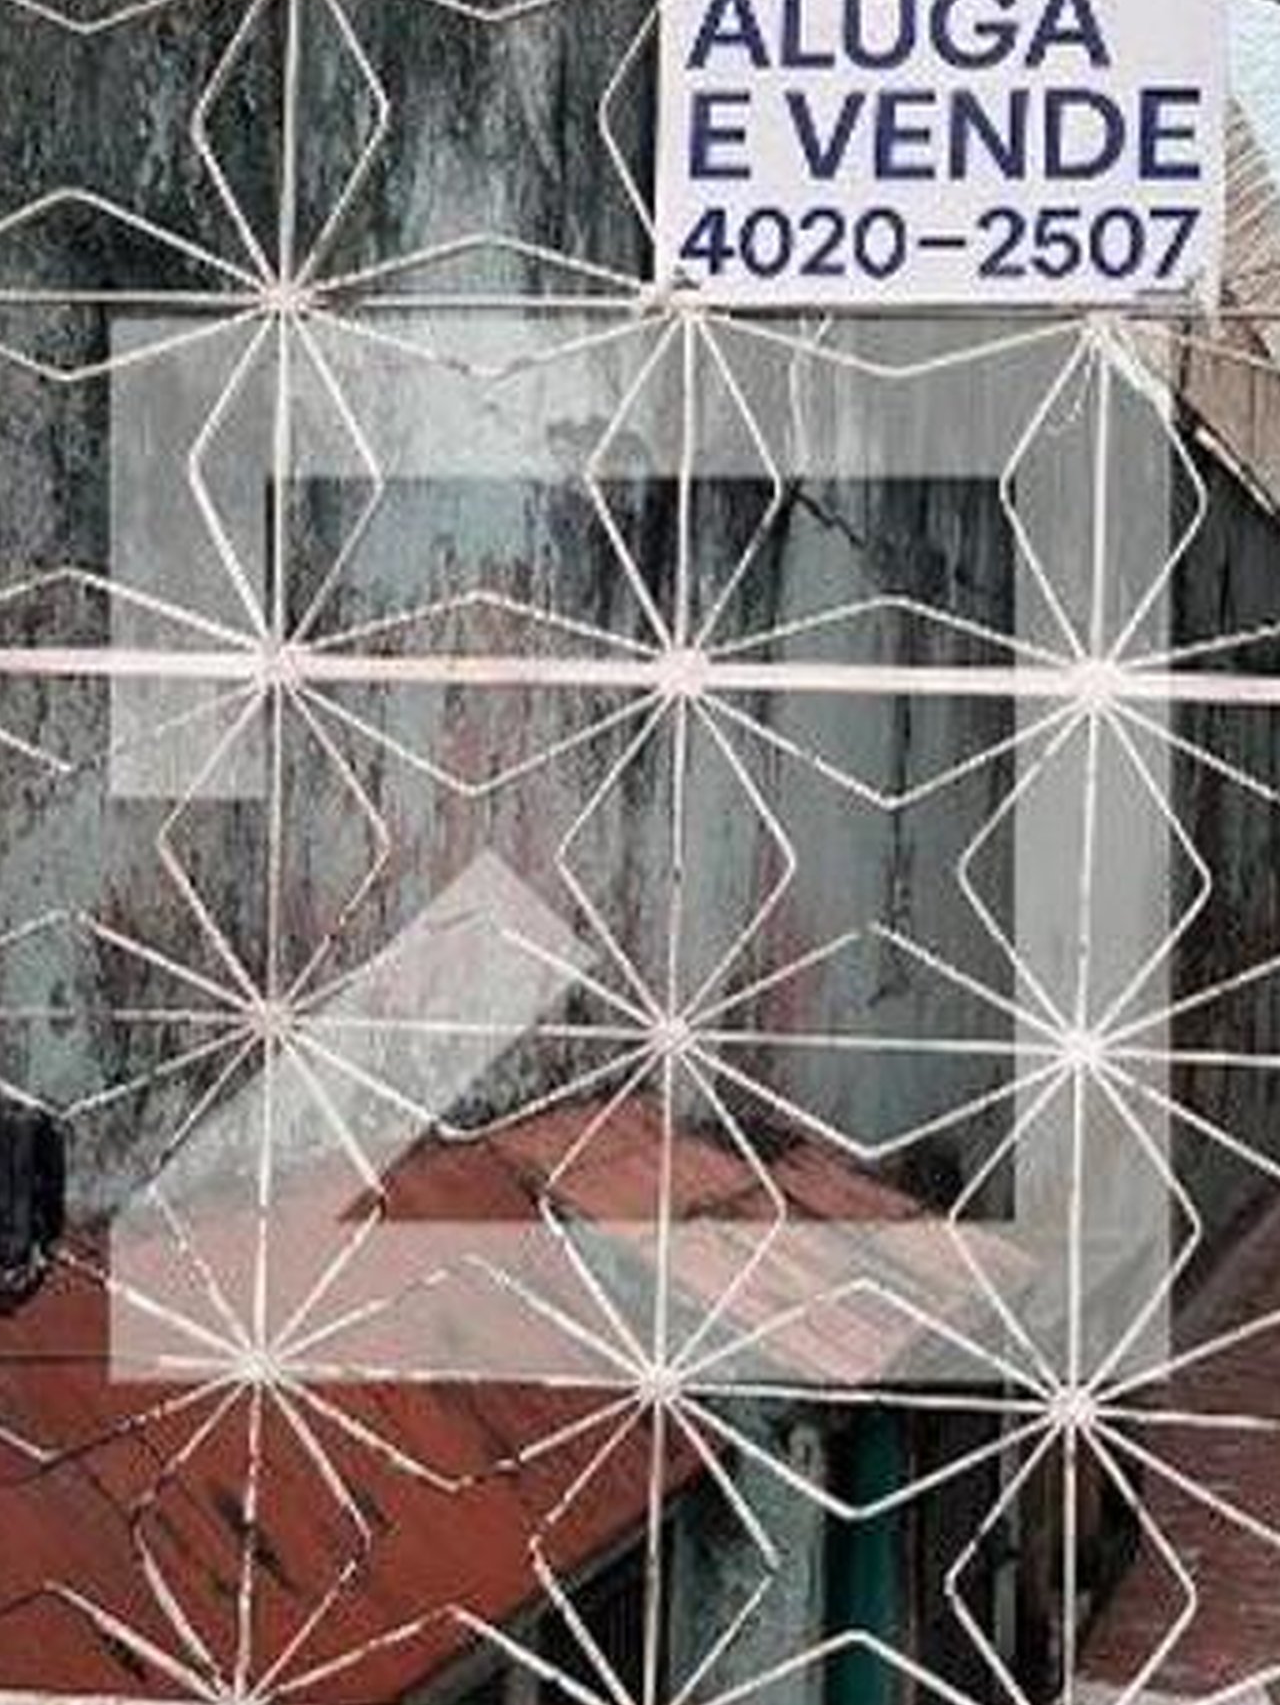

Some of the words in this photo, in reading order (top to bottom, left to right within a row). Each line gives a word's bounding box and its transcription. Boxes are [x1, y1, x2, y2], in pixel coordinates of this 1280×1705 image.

[688, 87, 751, 180] E
[784, 87, 1202, 181] VENDE
[679, 207, 1200, 280] 4020-2507
